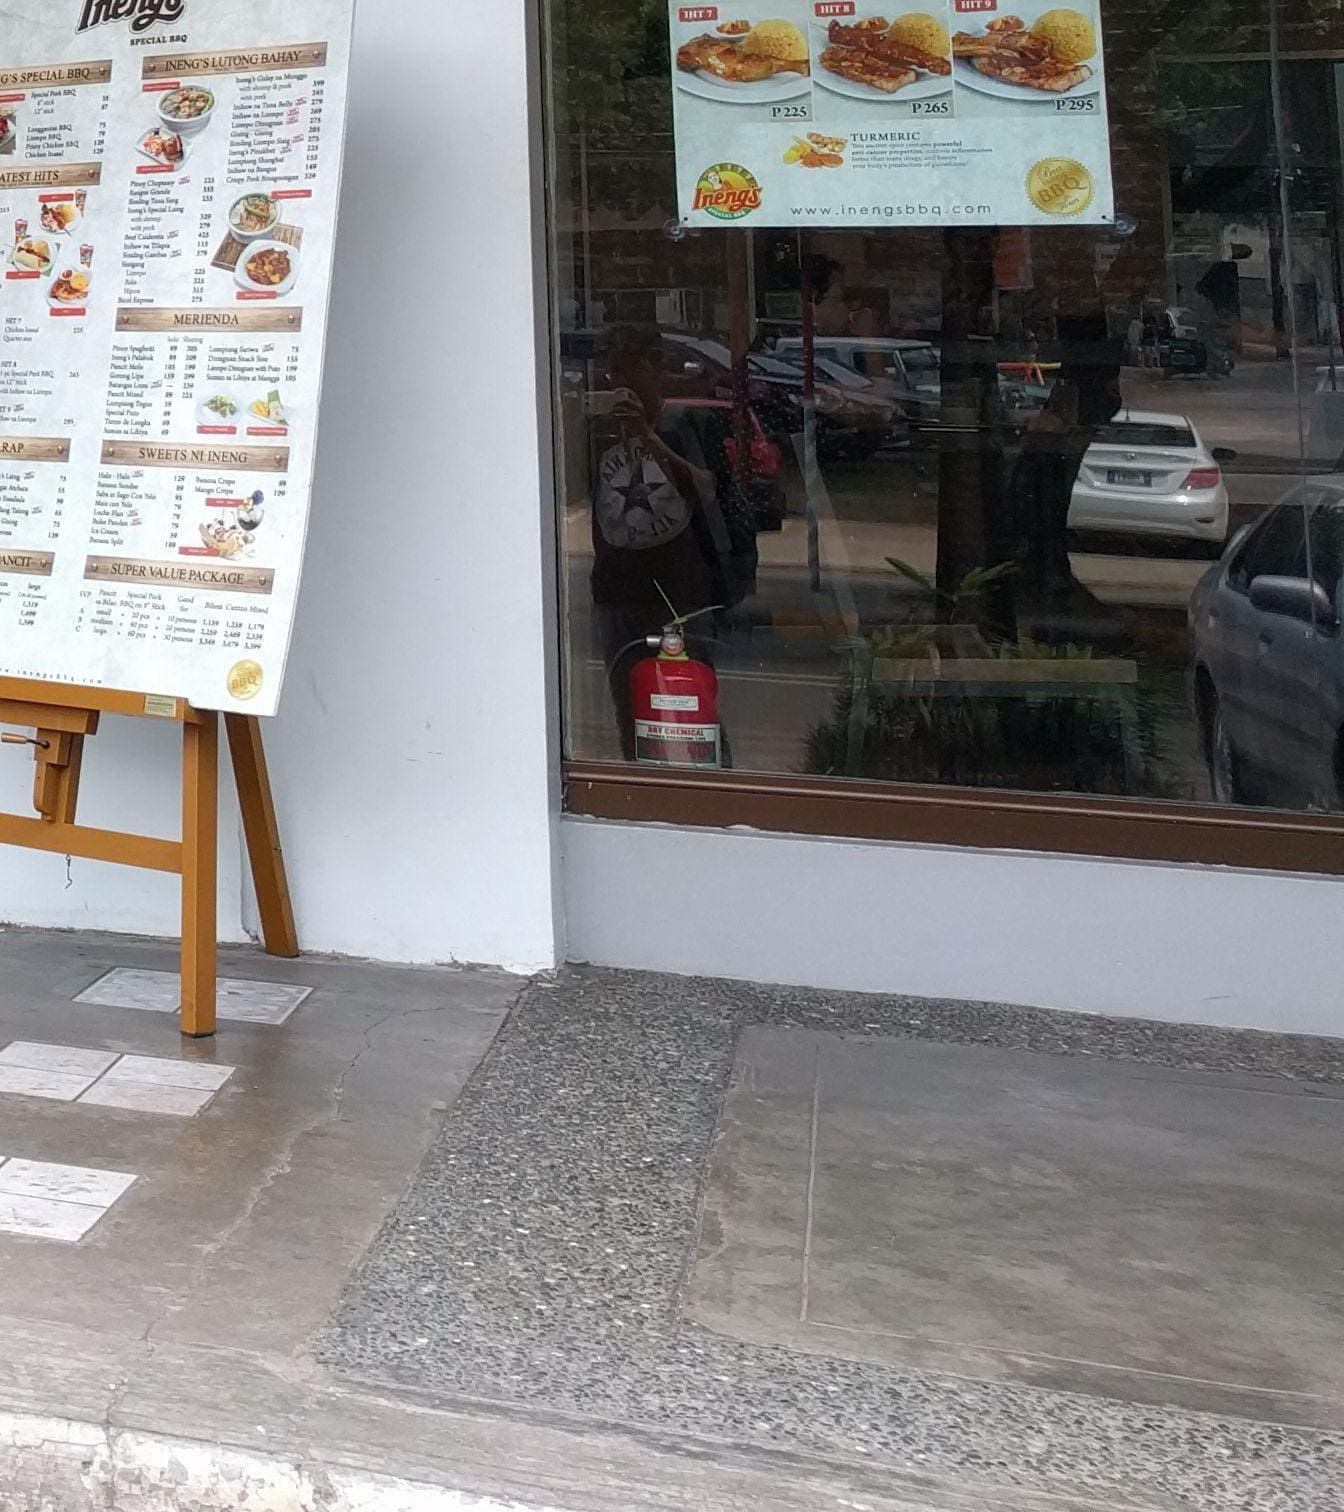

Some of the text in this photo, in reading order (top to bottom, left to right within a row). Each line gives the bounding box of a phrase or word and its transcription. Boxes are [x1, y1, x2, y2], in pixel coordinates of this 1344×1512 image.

[821, 3, 850, 14] HIT 8
[961, 0, 981, 10] HIT
[684, 9, 712, 21] HIT 7
[130, 35, 188, 46] SPECIAL BBQ
[165, 50, 302, 71] INENG'S LUTONG BAHAY
[20, 70, 65, 83] SPECIAL
[67, 67, 90, 80] BBQ
[771, 105, 807, 118] P 225
[912, 101, 948, 114] P 265
[1055, 98, 1094, 112] P 295
[850, 132, 921, 142] TURMERIC
[34, 170, 59, 181] HITS
[790, 203, 992, 217] www.inengsbbq.com
[173, 313, 239, 325] MERIENDA
[138, 447, 248, 463] SWEETS NI INENG
[111, 563, 244, 584] SUPER VALUE PACKAGE
